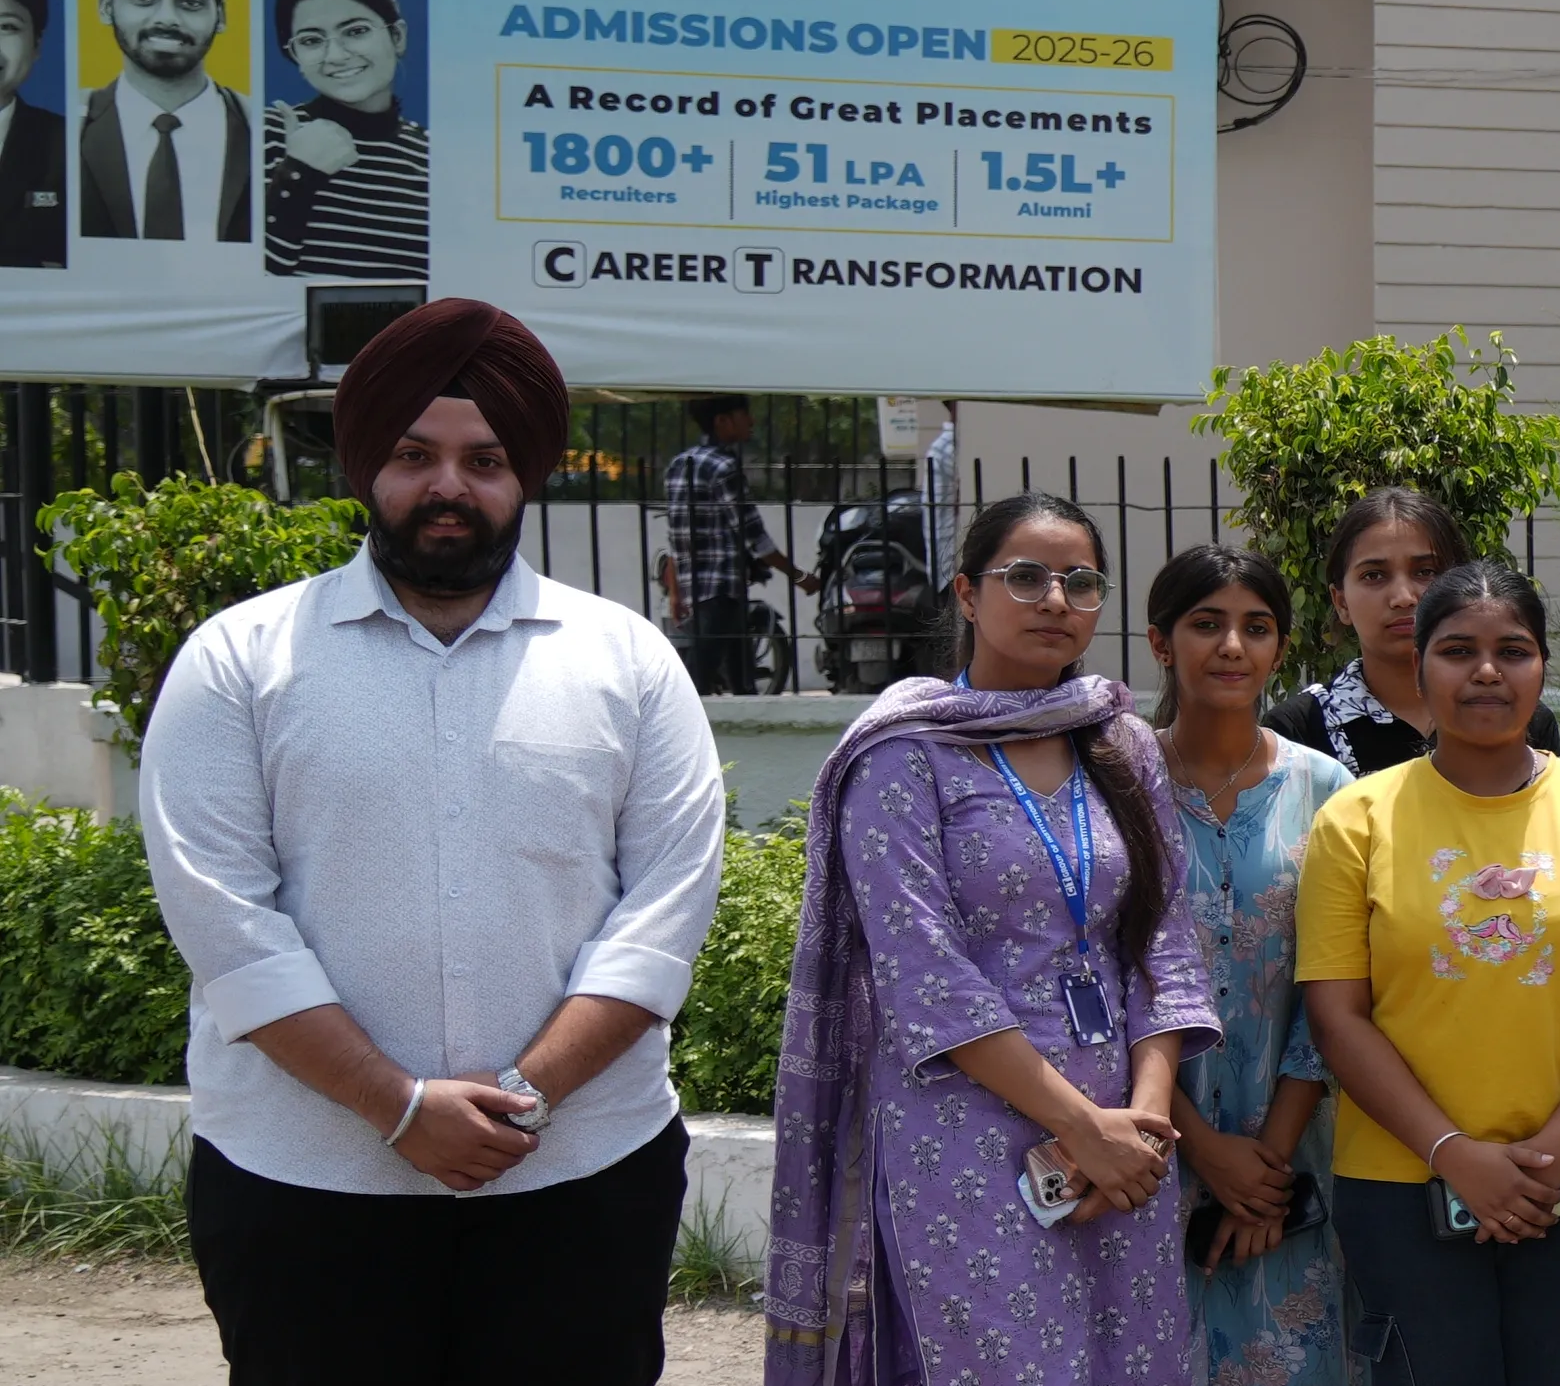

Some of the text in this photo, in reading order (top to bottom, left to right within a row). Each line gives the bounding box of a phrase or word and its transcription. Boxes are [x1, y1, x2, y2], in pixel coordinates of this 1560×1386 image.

[500, 4, 1155, 68] ADMISSIONS OPEN 2025-26
[524, 84, 1154, 136] A Record of Great Placements
[523, 131, 714, 179] 1800+
[765, 142, 925, 187] 51 LPA
[980, 151, 1126, 195] 1.5L+
[560, 184, 677, 205] Recruiters
[755, 189, 939, 214] Highest Package
[1017, 201, 1092, 219] Alumni
[1025, 799, 1053, 844] INSTITUTIONS
[1077, 802, 1090, 849] INSTITUTIONS
[1051, 844, 1060, 855] OF
[1056, 857, 1072, 878] GROUP
